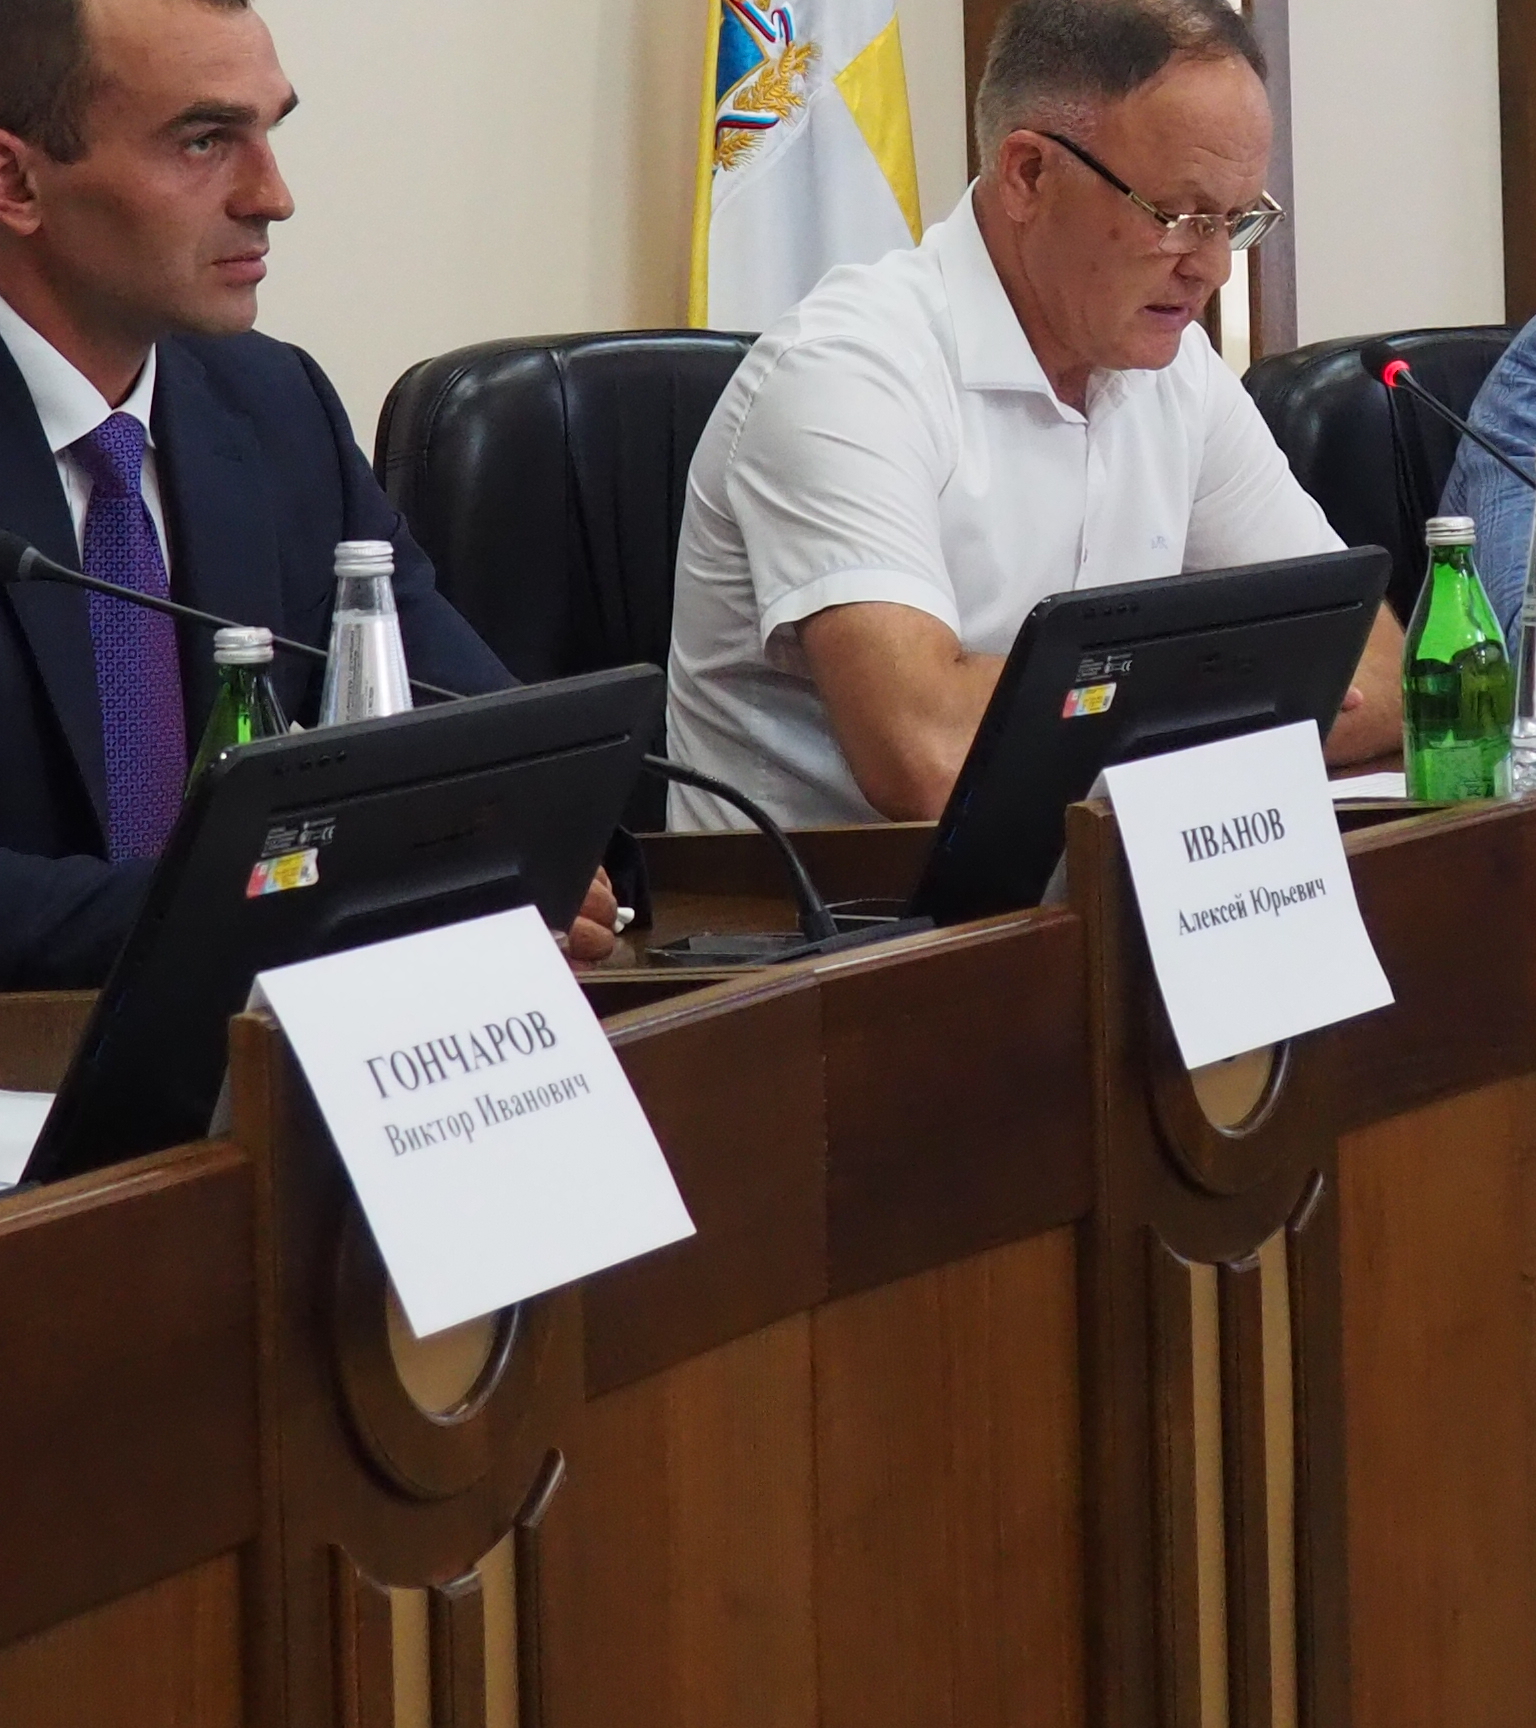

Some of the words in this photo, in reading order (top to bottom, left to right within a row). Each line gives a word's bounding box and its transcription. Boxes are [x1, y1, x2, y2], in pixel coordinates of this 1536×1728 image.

[1180, 808, 1286, 863] ИВАНОВ
[1179, 893, 1248, 936] Алексей
[1249, 878, 1327, 917] Юрьевич
[365, 1010, 557, 1099] ГОНЧАРОВ
[384, 1110, 476, 1157] Виктор
[474, 1073, 592, 1128] Иванович
